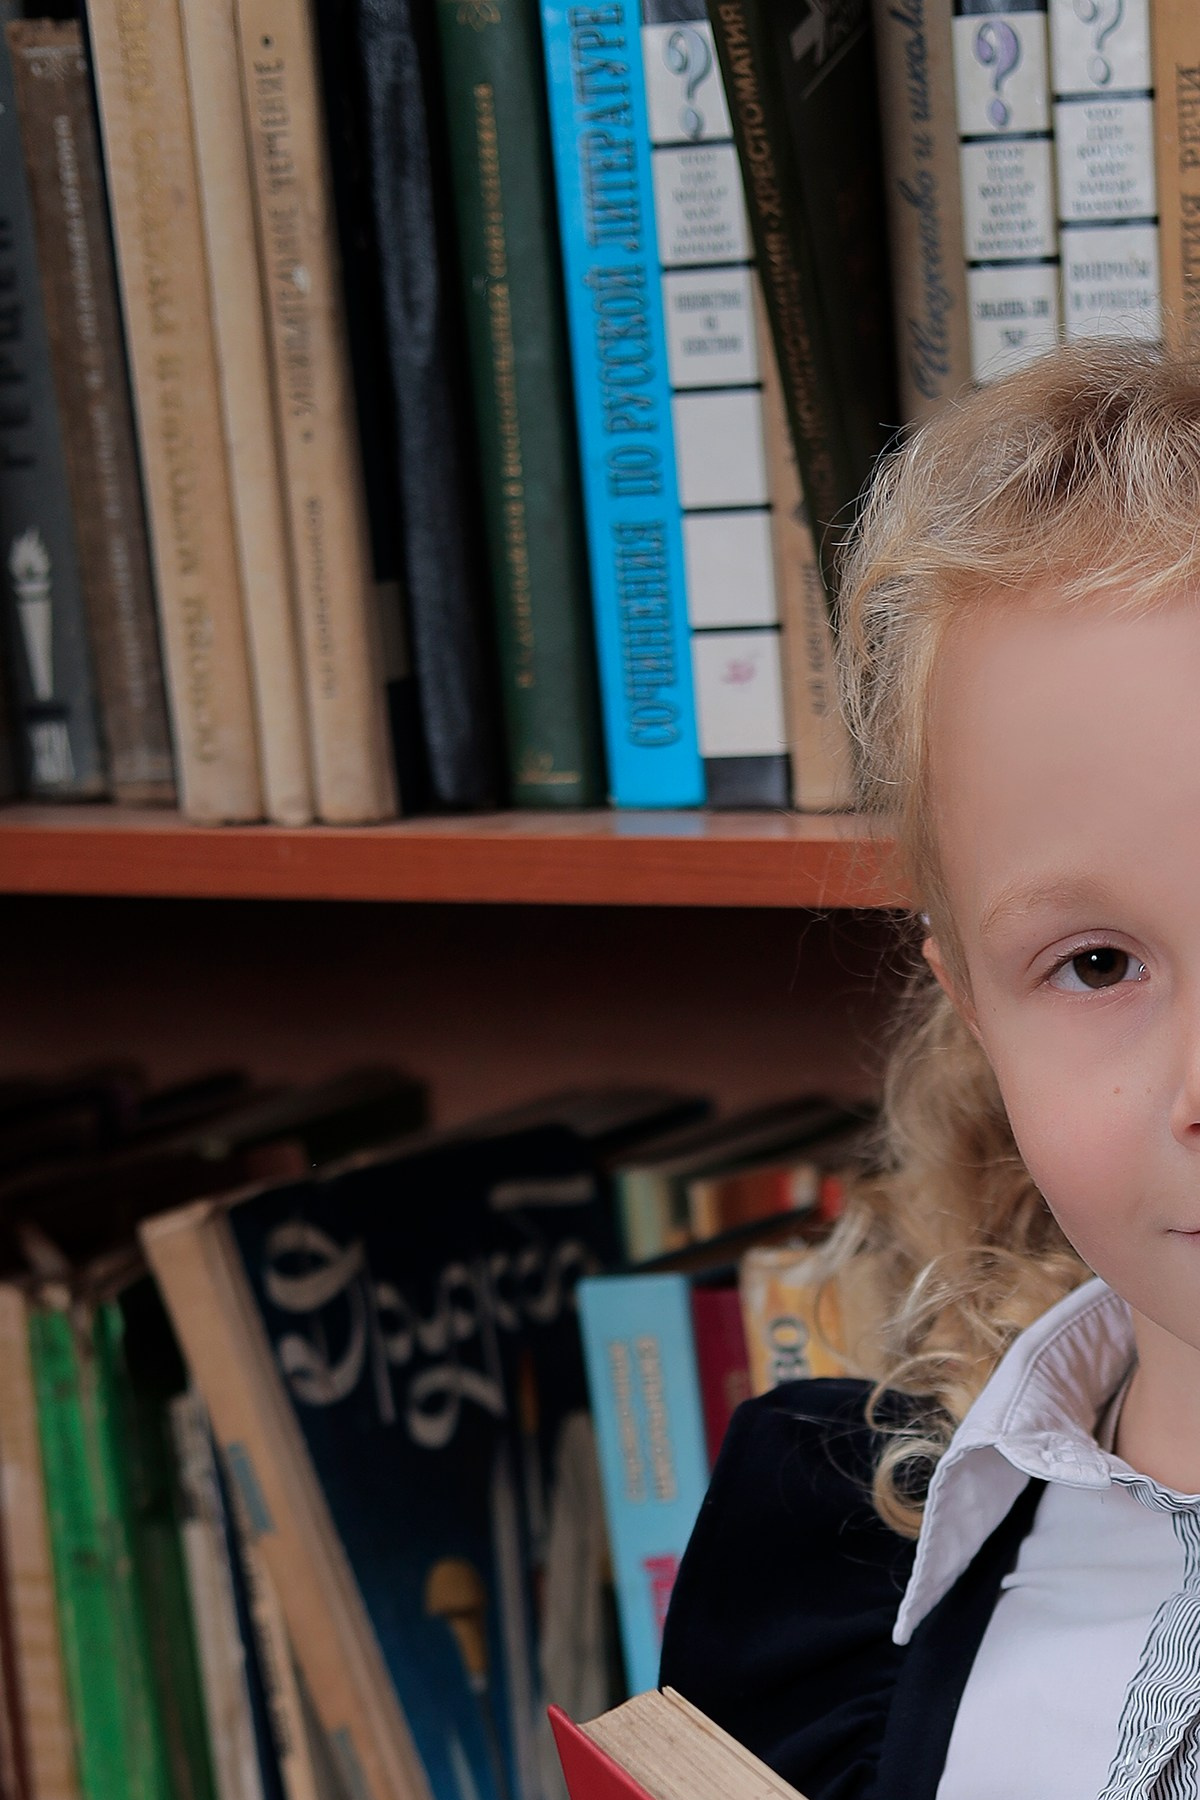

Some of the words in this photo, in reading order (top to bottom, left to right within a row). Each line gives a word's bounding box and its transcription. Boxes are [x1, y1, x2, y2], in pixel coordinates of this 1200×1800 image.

[571, 2, 643, 251] ЛИТЕРАТУРЕ
[717, 3, 783, 218] ХРЕСТОМАТИЯ
[911, 133, 934, 166] и
[590, 264, 663, 437] РУССКОЙ
[616, 443, 665, 497] ПО
[613, 520, 680, 748] СОЧИНЕНИЯ
